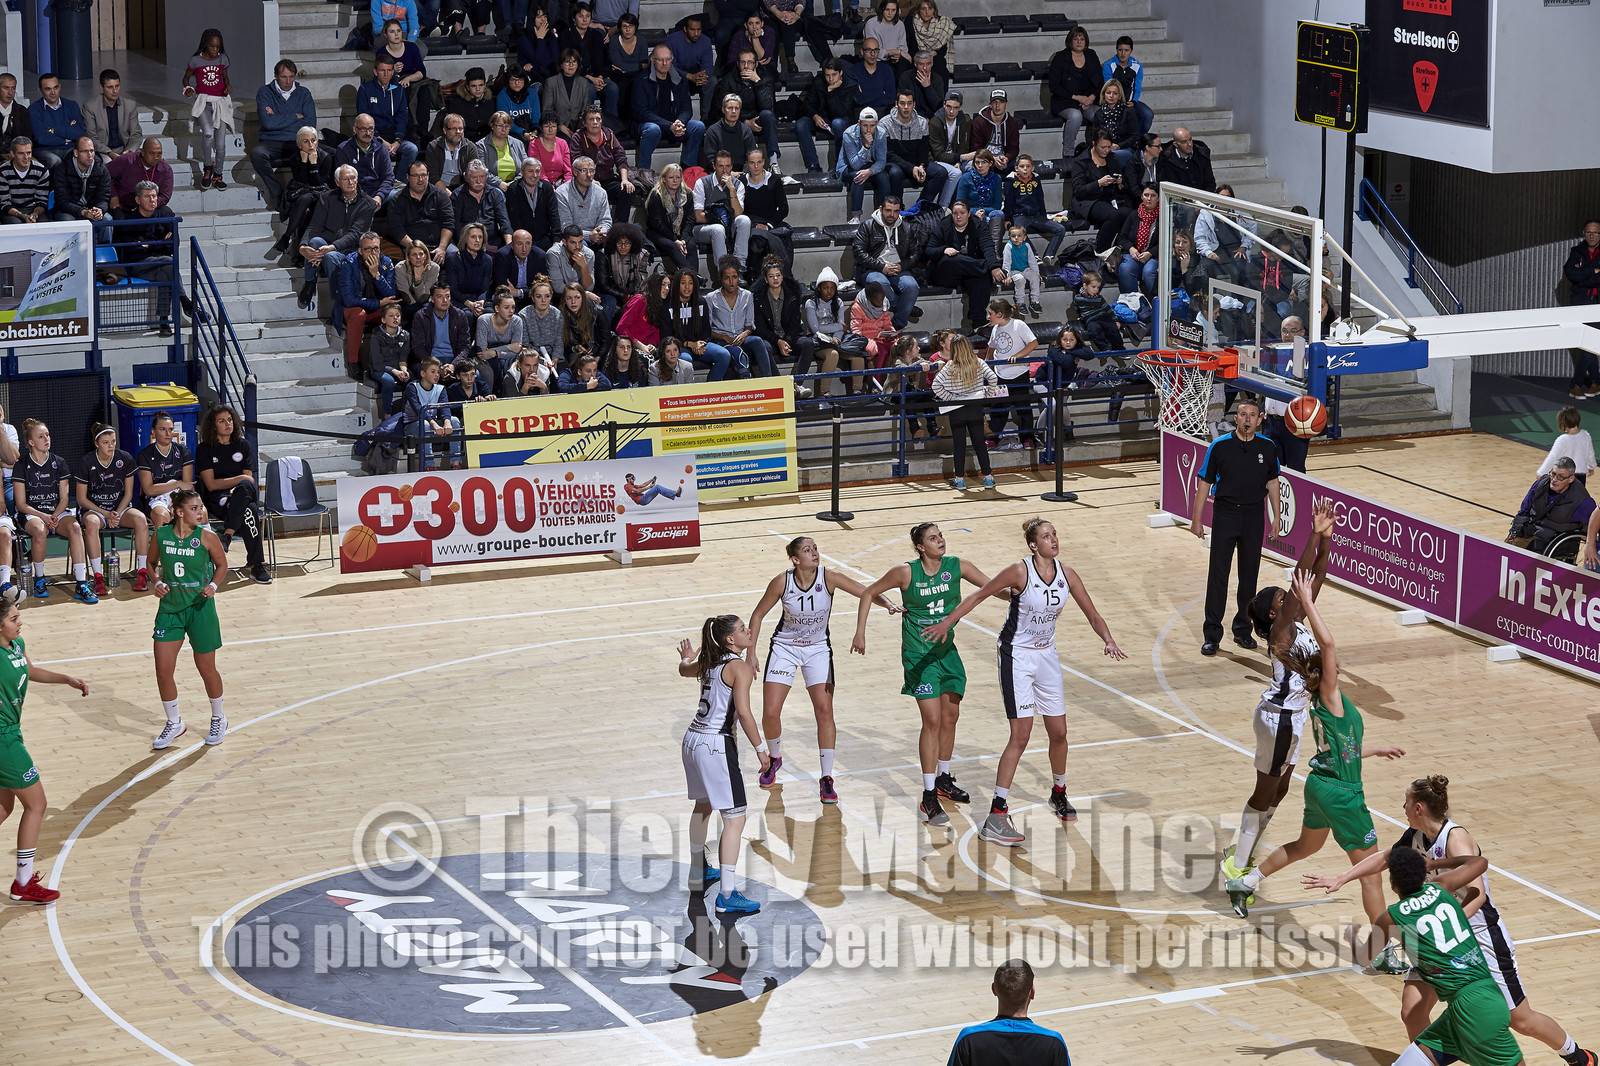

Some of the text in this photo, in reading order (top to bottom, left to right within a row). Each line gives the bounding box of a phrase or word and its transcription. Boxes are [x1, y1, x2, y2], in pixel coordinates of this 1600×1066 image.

[1394, 27, 1445, 49] Strellson
[1415, 66, 1436, 76] Strellson
[233, 138, 242, 148] G
[54, 269, 76, 283] BOIS
[36, 284, 63, 300] VISITER
[307, 301, 315, 312] D
[331, 358, 339, 369] C
[721, 393, 747, 402] particuliers
[357, 416, 366, 427] B
[667, 412, 690, 420] Faire-part
[694, 409, 713, 418] mariage,
[714, 408, 739, 416] naissance,
[479, 412, 582, 436] SUPER
[669, 439, 696, 448] Calendriers
[697, 437, 716, 446] sportifs,
[762, 431, 780, 439] tombola
[728, 477, 749, 485] panneaux
[762, 473, 781, 481] véhicule
[536, 480, 616, 501] VÉHICULES
[539, 500, 616, 516] D'OCCASION
[540, 513, 616, 528] TOUTES MARQUES
[437, 530, 617, 556] www.groupe-boucher.fr
[636, 526, 689, 544] BOUCHER
[1368, 512, 1402, 549] FOR
[1408, 526, 1446, 564] YOU
[165, 546, 176, 554] UNI
[1331, 532, 1445, 583] agence immobilière à Angers
[174, 561, 185, 577] 6
[920, 588, 932, 596] UNI
[1043, 589, 1061, 606] 15
[1499, 555, 1600, 632] In Exte
[797, 595, 814, 612] 11
[926, 599, 944, 615] 14
[1416, 902, 1471, 954] 22
